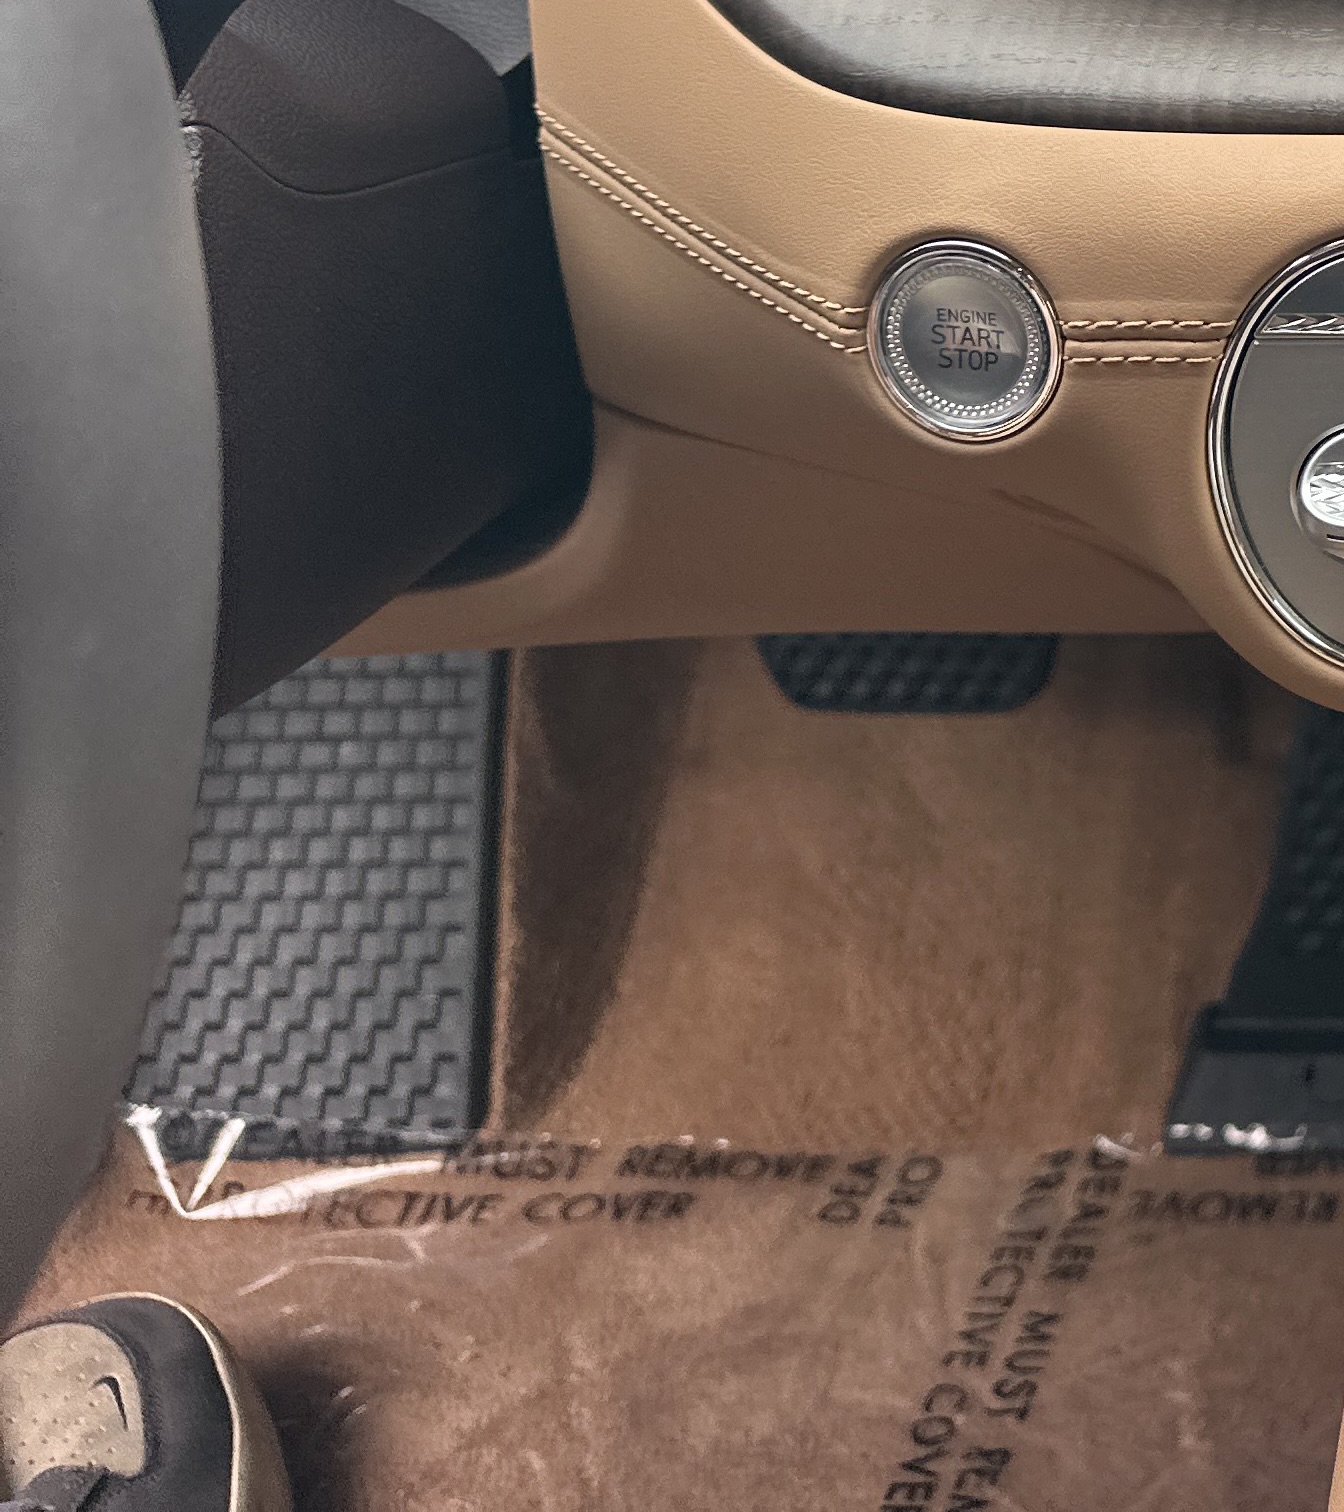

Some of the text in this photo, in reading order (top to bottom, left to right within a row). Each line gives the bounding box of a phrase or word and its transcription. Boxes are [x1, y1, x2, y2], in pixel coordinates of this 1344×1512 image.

[936, 307, 998, 327] ENGINE
[931, 324, 1005, 349] START
[938, 347, 999, 372] STOP
[521, 1191, 695, 1226] COVER
[984, 1310, 1063, 1423] MUST
